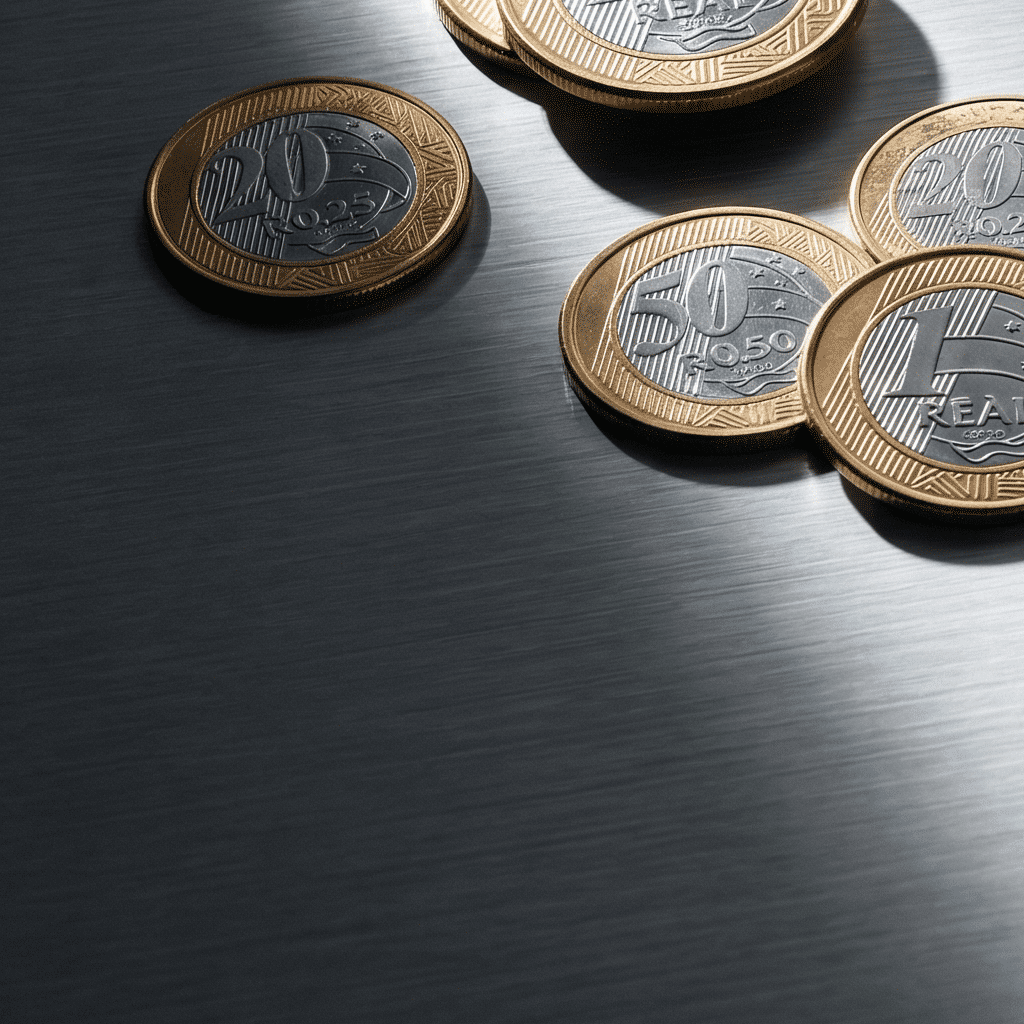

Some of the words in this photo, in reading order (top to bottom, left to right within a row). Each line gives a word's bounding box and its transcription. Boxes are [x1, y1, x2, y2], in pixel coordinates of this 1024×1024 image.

[209, 128, 330, 226] 20
[908, 141, 1023, 219] 20
[630, 260, 749, 357] 50
[882, 305, 954, 398] 1
